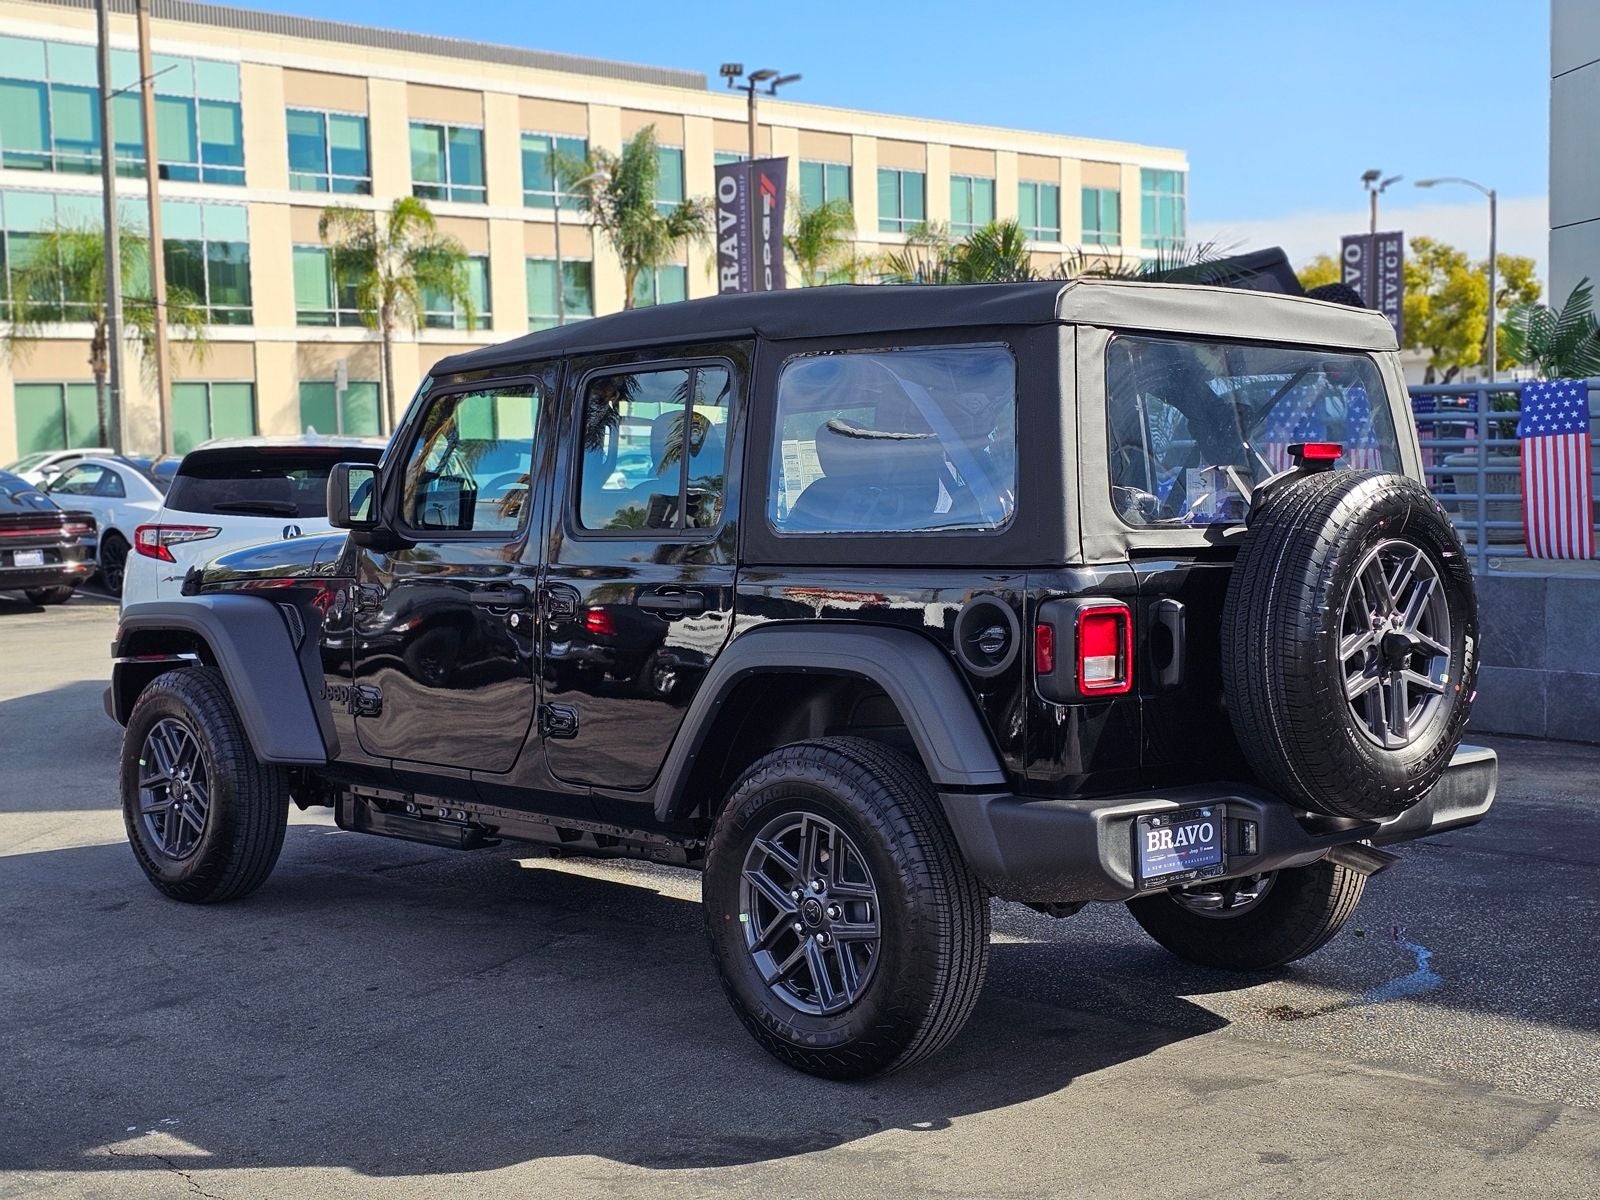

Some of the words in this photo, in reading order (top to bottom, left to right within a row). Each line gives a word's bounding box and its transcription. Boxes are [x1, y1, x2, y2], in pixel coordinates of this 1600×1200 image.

[718, 176, 739, 291] RAVO
[763, 193, 772, 291] ODGE
[1385, 241, 1397, 325] ERVICE
[320, 680, 350, 705] Jeep
[1146, 823, 1214, 852] BRAVO
